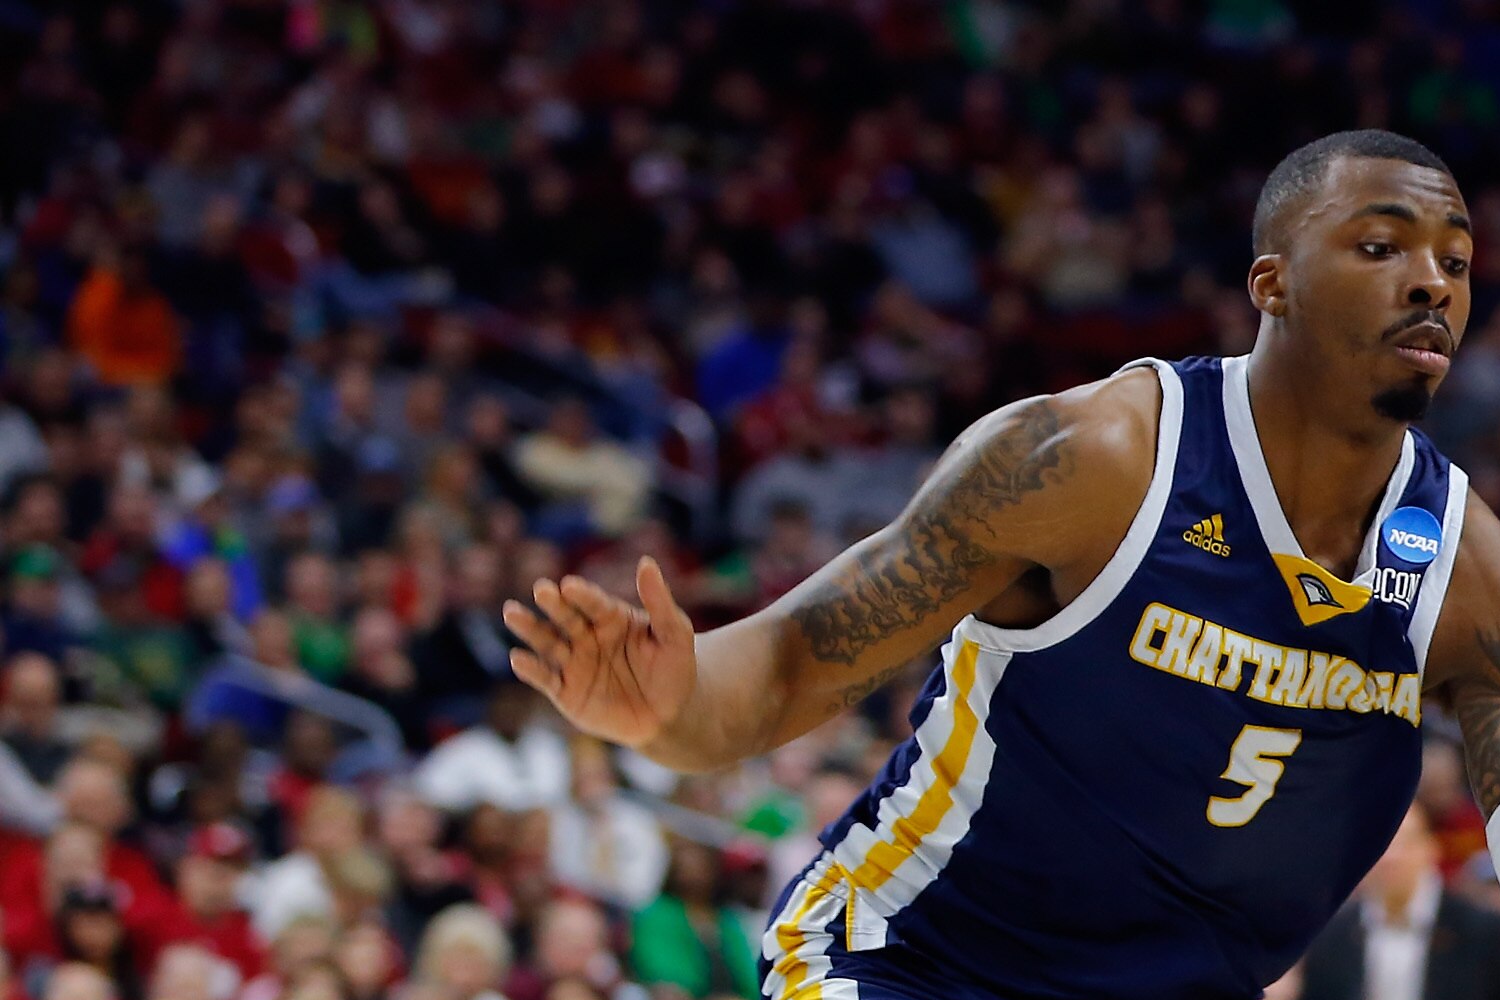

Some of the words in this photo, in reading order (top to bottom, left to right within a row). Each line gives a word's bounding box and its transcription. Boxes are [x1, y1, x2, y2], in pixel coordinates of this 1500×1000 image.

[1182, 530, 1231, 557] adidas
[1389, 528, 1438, 555] NCAA
[1206, 724, 1302, 828] 5
